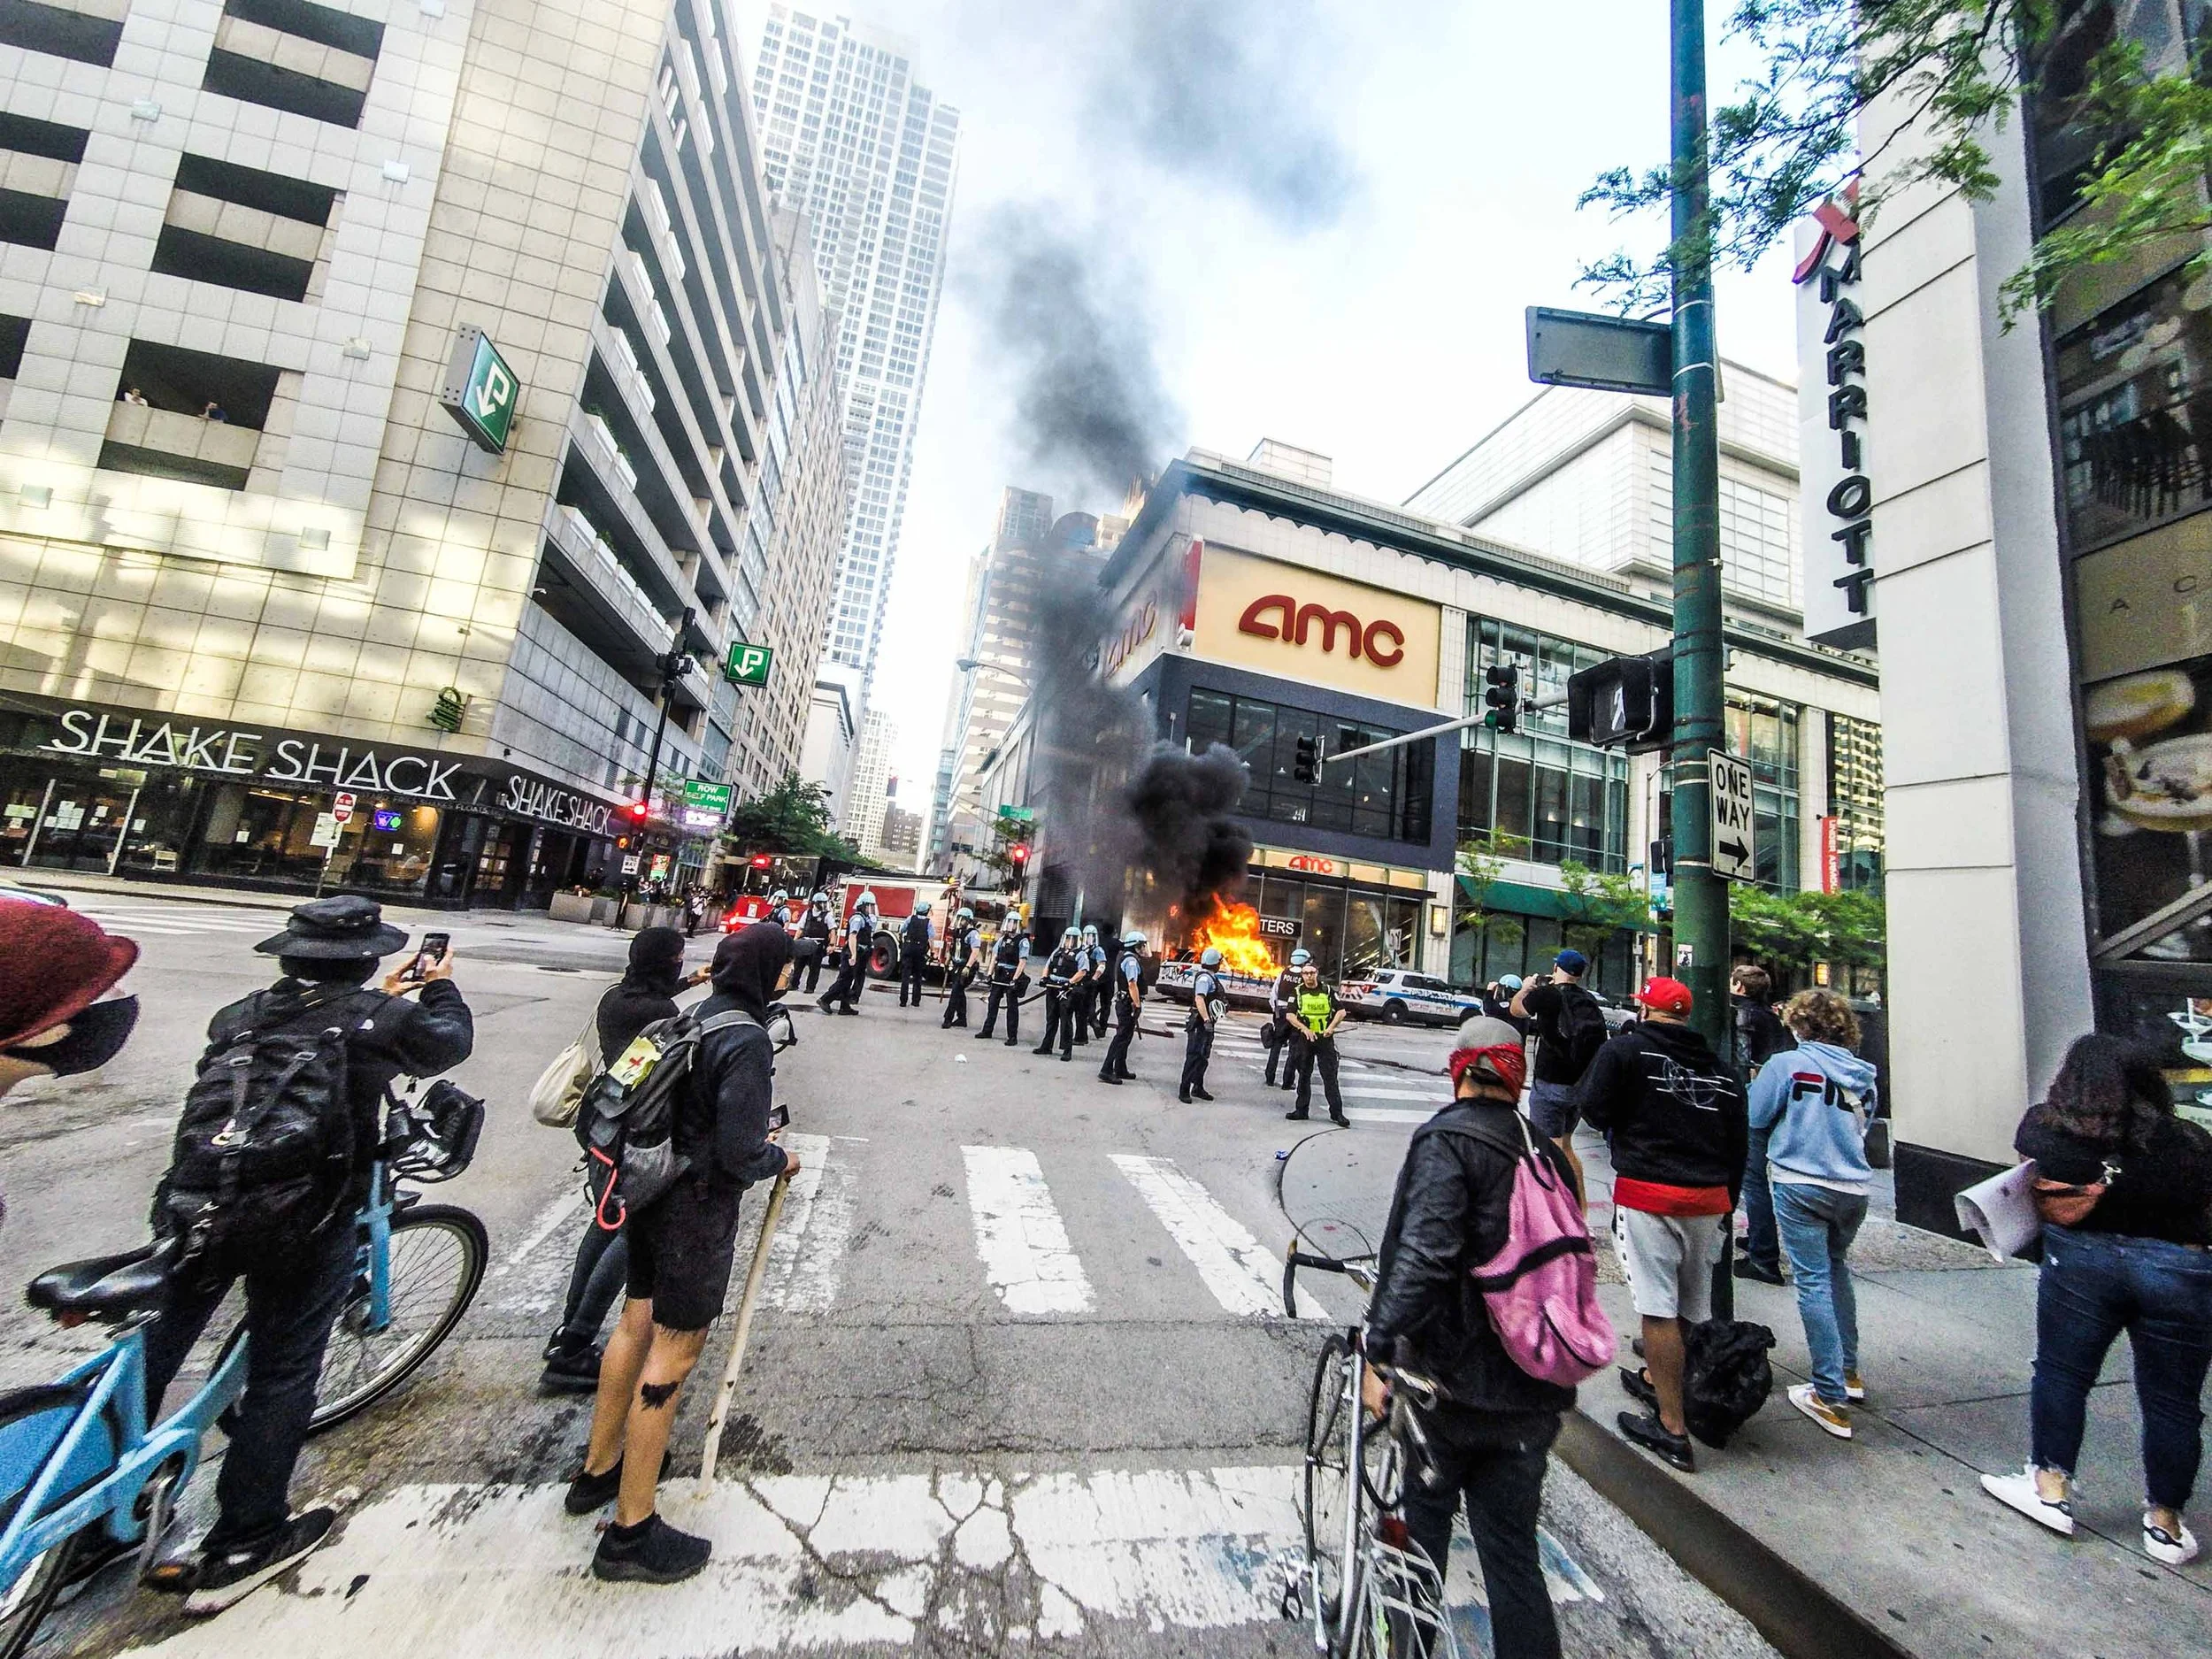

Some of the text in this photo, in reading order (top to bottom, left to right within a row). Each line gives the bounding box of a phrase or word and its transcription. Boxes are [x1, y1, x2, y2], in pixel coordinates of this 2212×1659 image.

[1819, 242, 1874, 614] MARRIOTT
[50, 710, 263, 775] SHAKE
[266, 740, 464, 801] SHACK
[696, 784, 719, 794] ROW
[705, 794, 727, 803] PARK
[1716, 764, 1749, 800] ONE
[505, 775, 613, 837] SHAKE SHACK
[1716, 795, 1750, 831] WAY
[1259, 918, 1295, 935] TERS
[1283, 974, 1302, 984] POLICE
